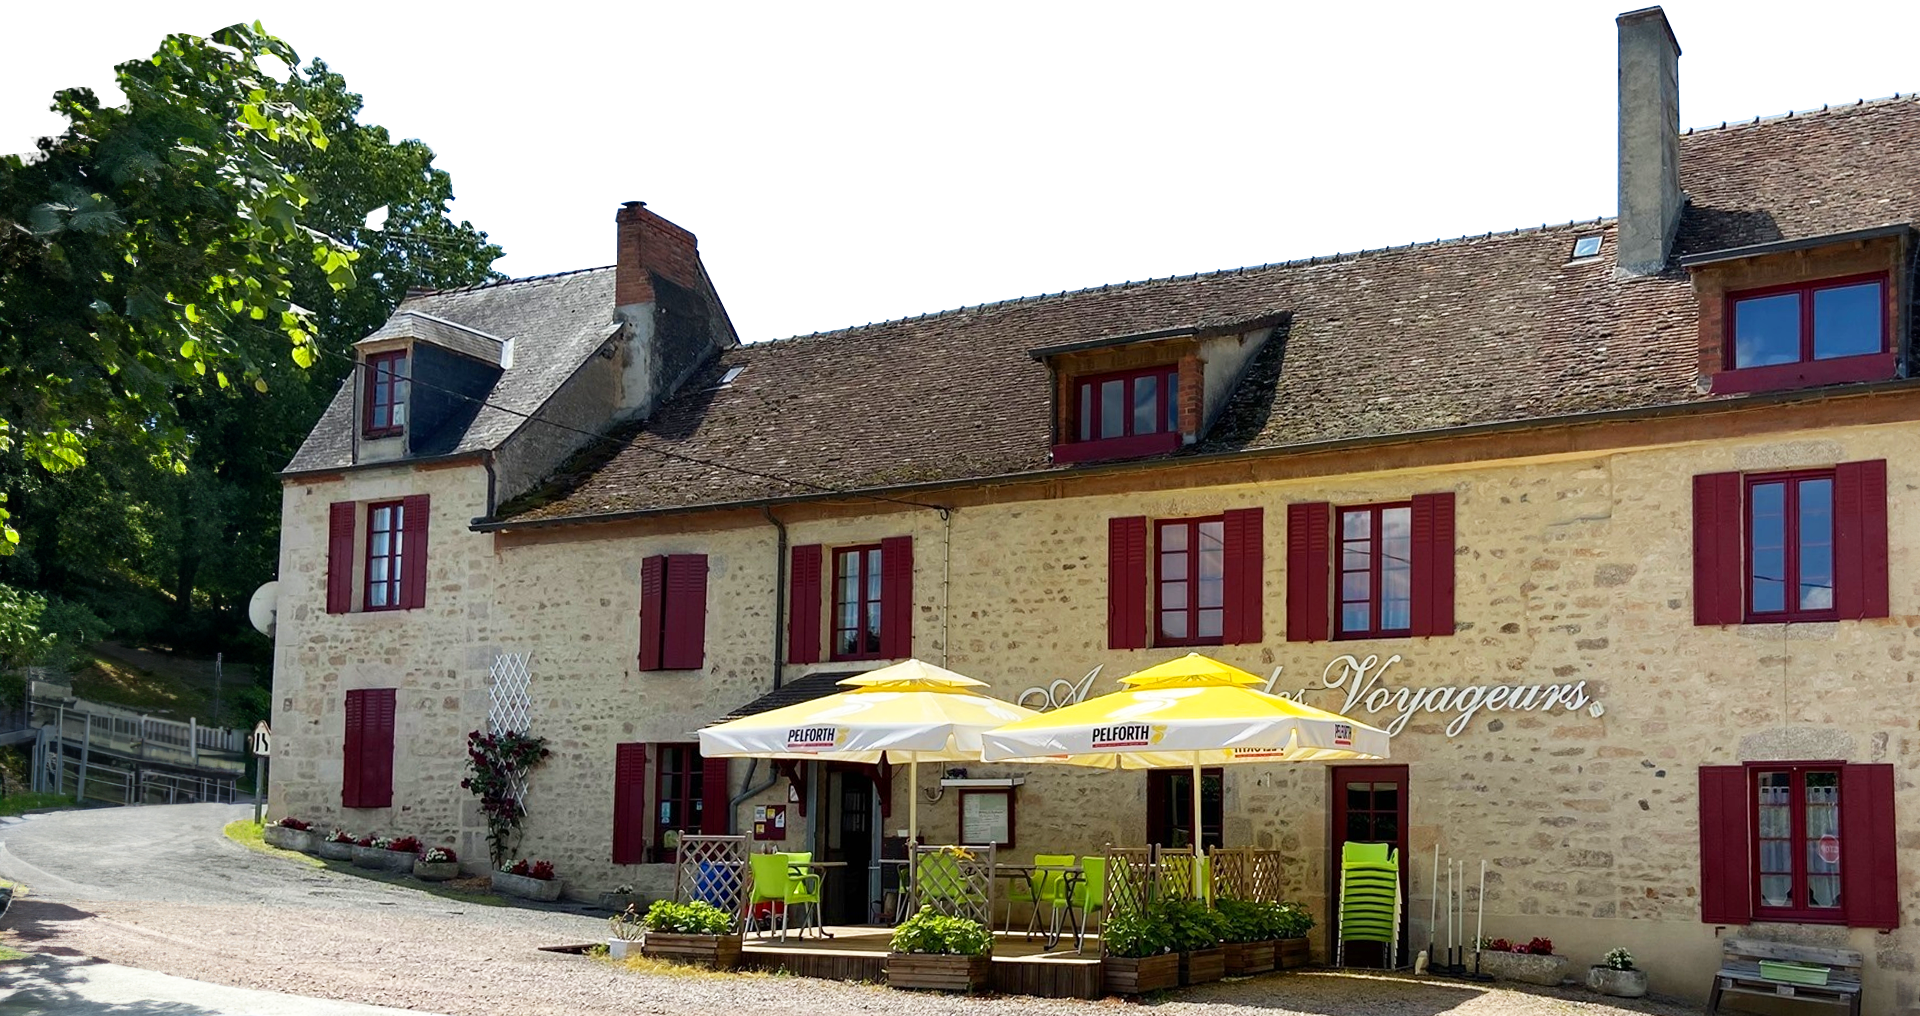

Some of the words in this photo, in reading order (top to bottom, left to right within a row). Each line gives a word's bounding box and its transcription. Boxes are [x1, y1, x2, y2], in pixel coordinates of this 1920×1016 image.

[1323, 653, 1589, 737] Voyageurs
[788, 728, 835, 742] PELFORTH
[1092, 725, 1149, 742] PELFORTH
